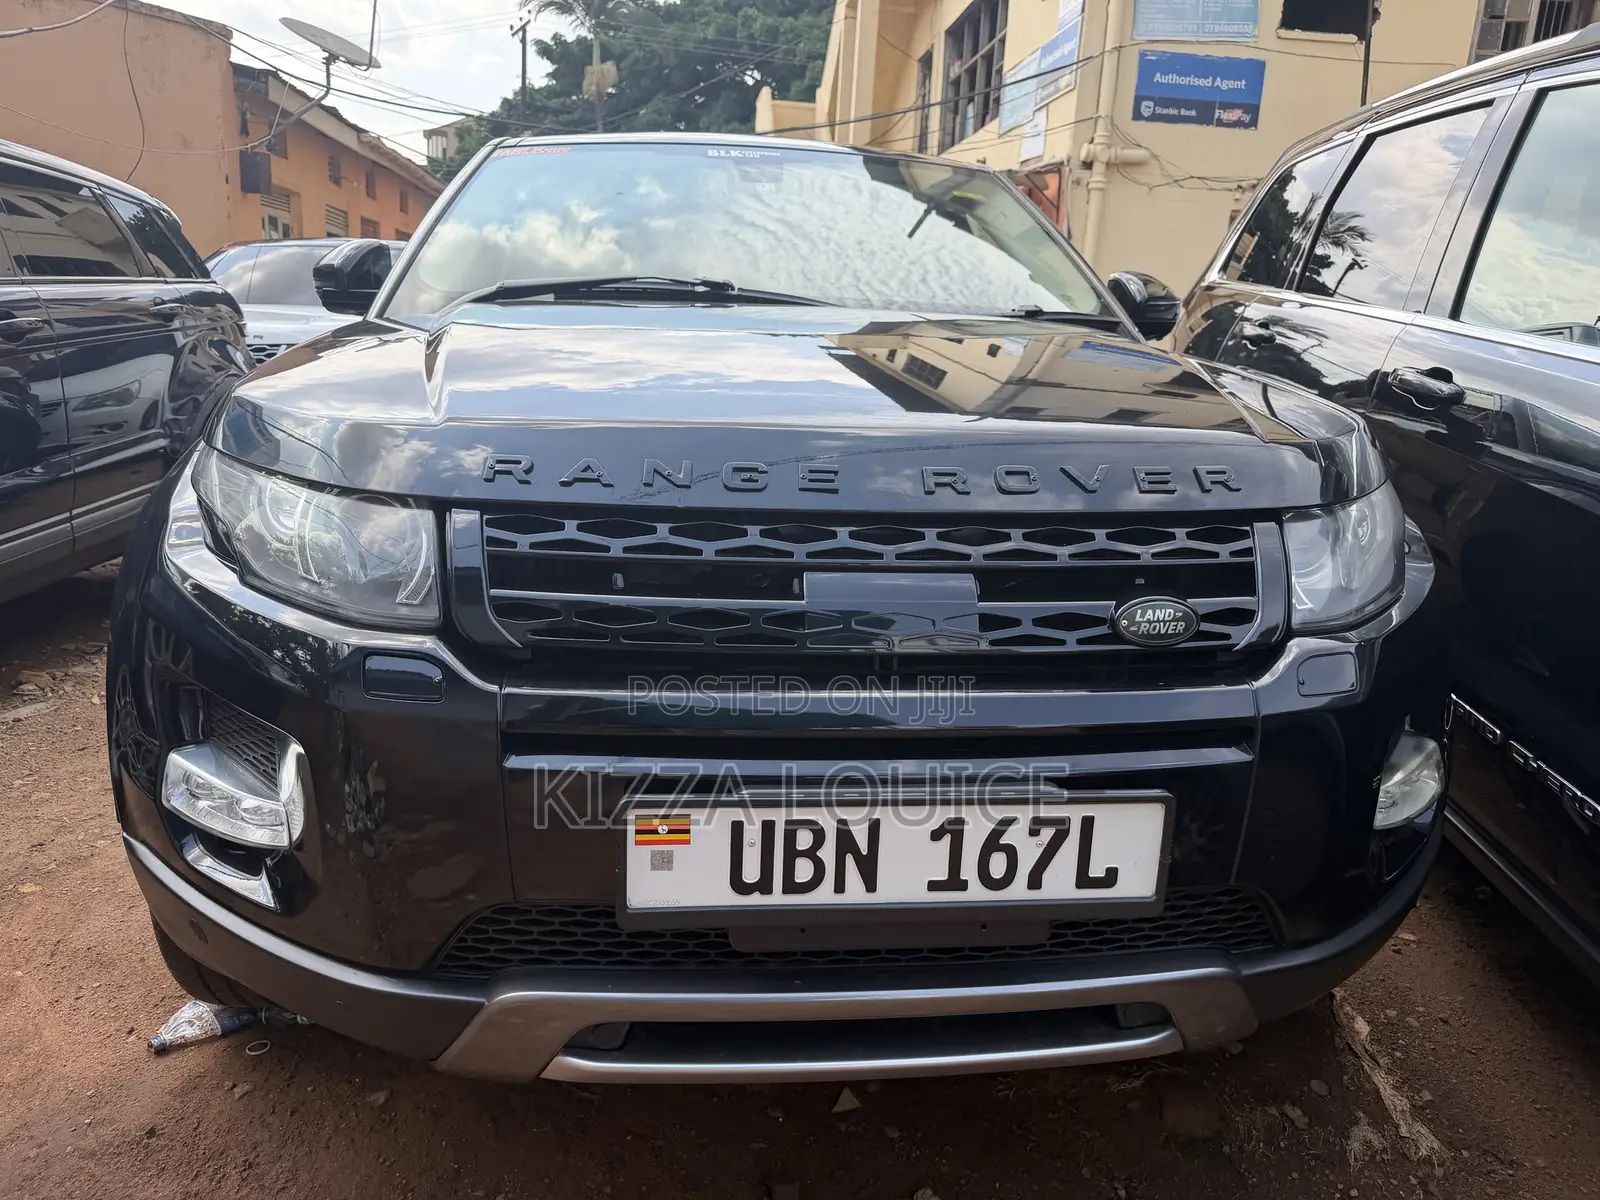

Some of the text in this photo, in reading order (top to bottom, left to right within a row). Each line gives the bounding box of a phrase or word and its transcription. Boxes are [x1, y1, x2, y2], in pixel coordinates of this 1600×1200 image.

[1153, 72, 1247, 90] Authorised Agent
[1155, 106, 1197, 116] Stanbic Bank
[1215, 109, 1252, 123] FlexiPay
[707, 149, 745, 157] BLK
[482, 454, 1243, 496] RANGE ROVER
[1135, 608, 1174, 622] LAND
[1138, 621, 1186, 635] ROVER
[728, 814, 1119, 895] UBN 167L
